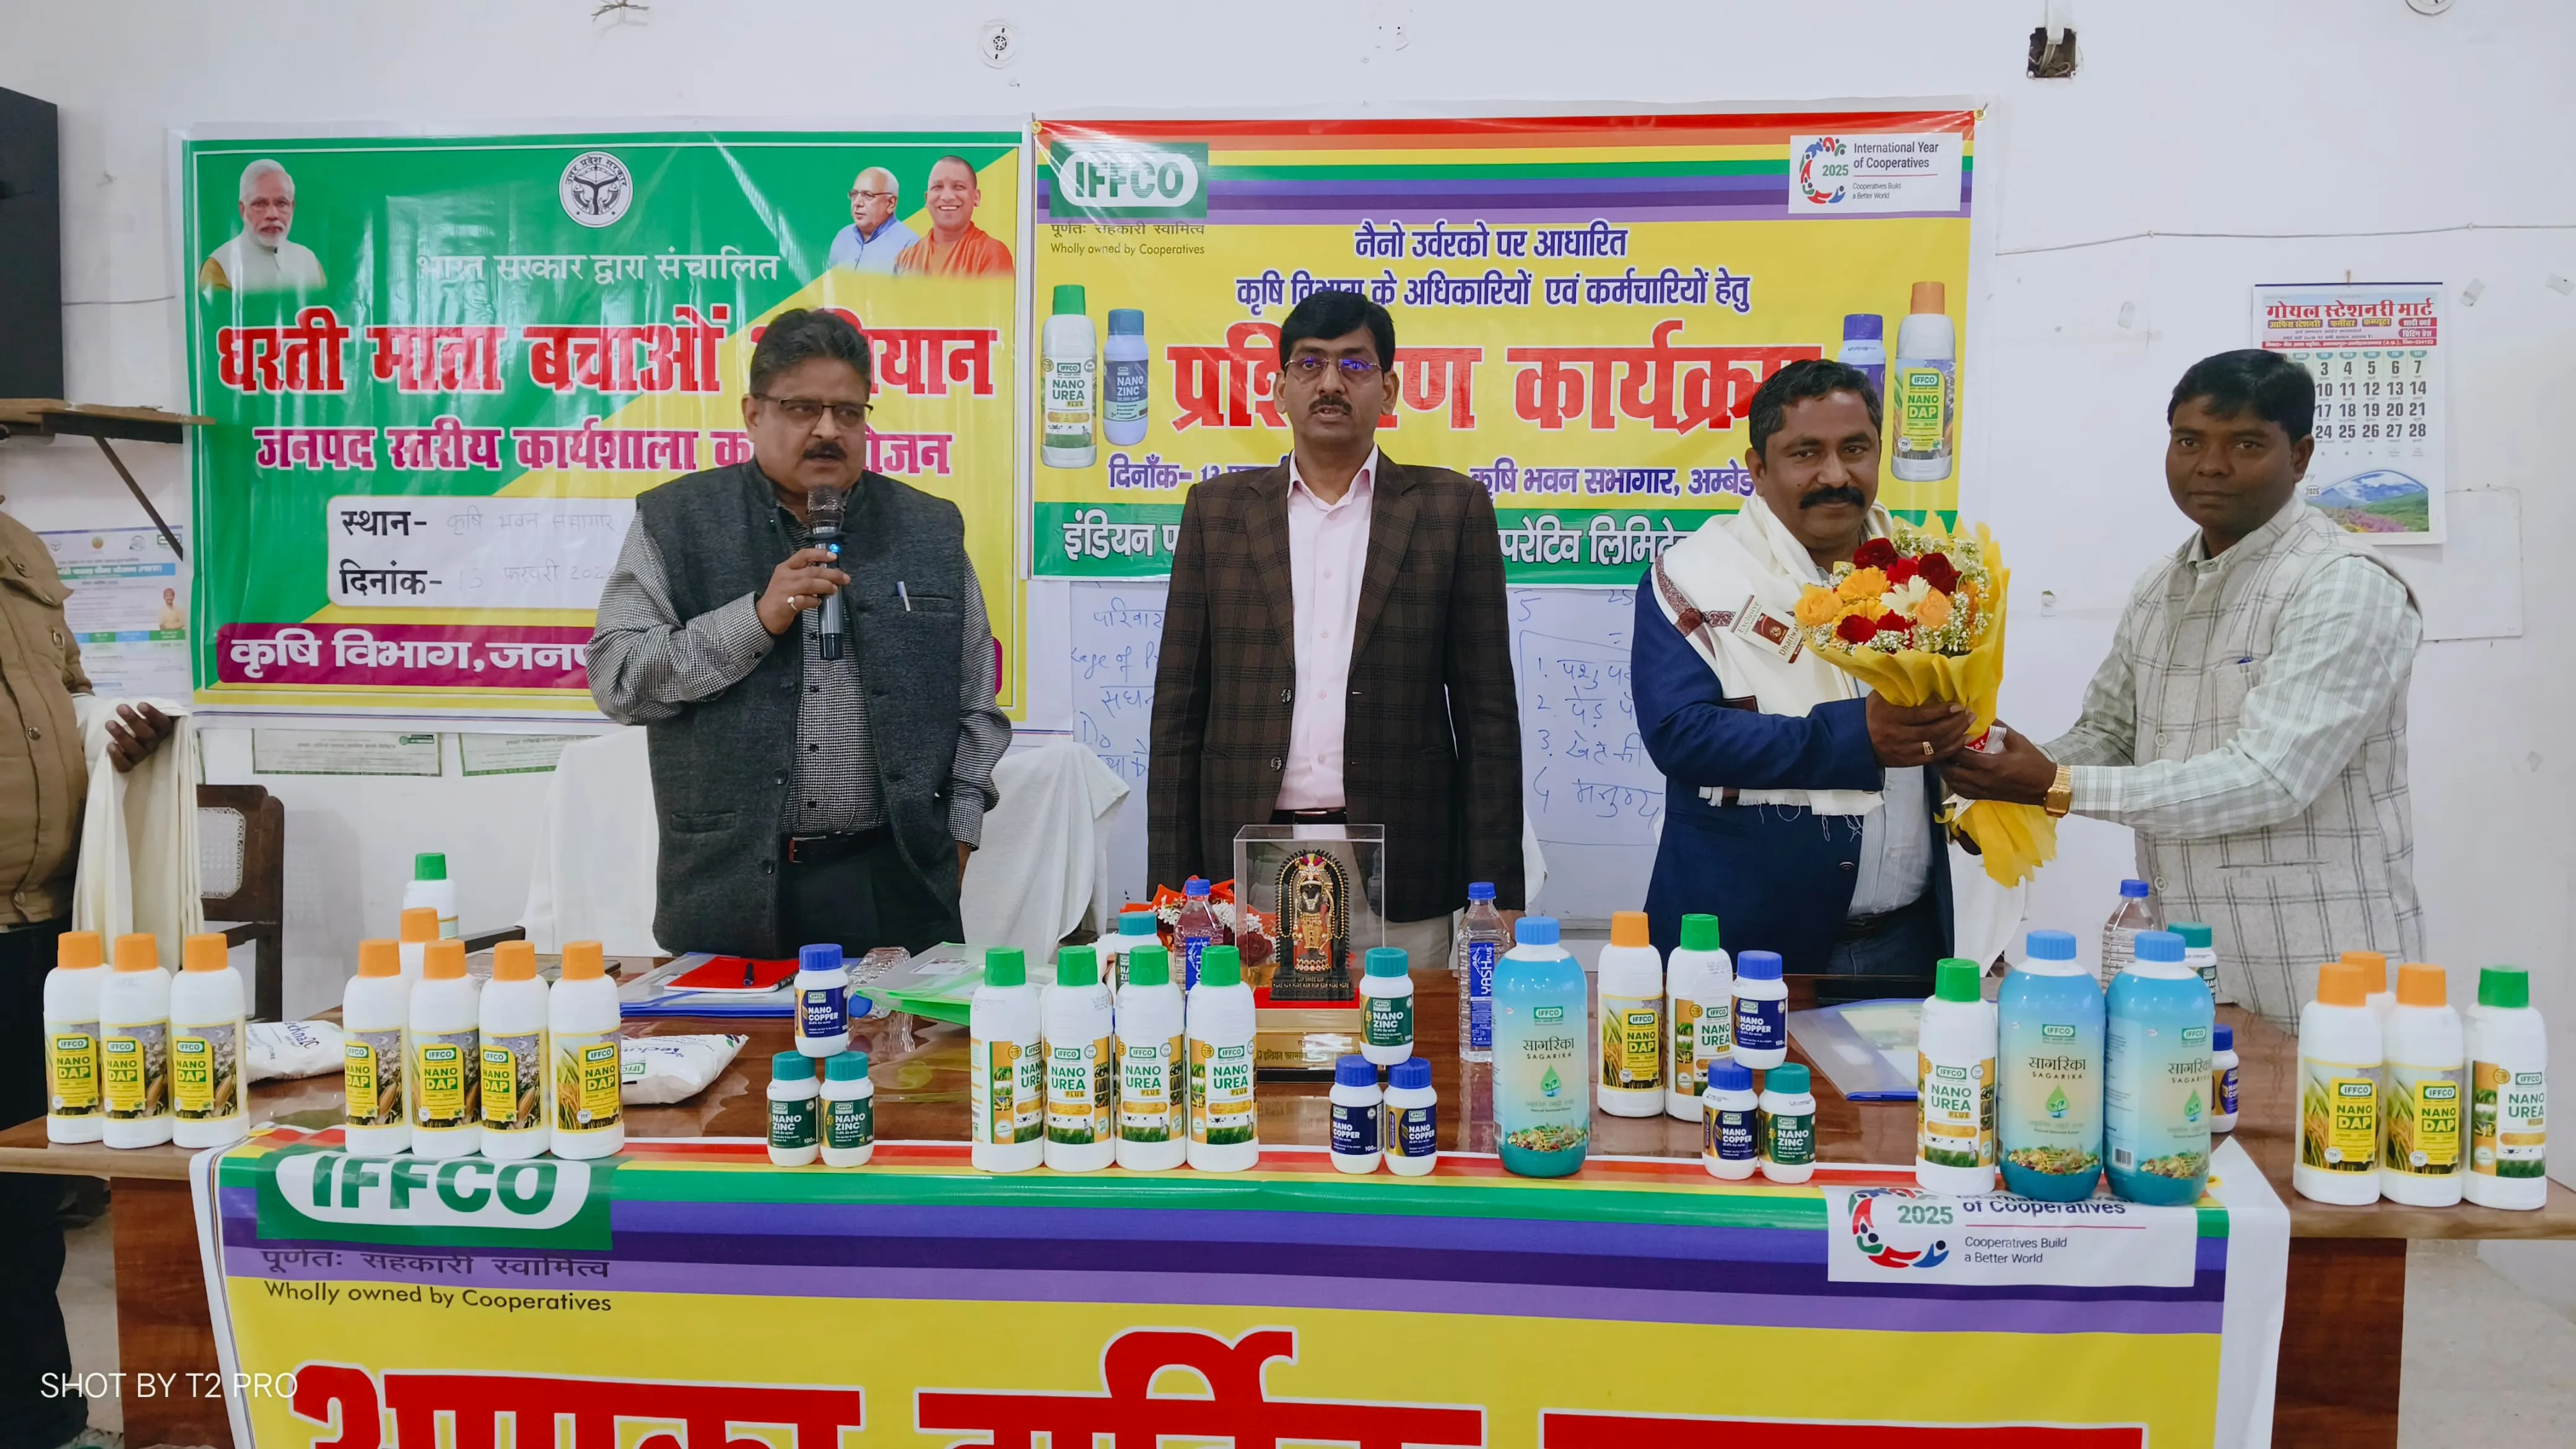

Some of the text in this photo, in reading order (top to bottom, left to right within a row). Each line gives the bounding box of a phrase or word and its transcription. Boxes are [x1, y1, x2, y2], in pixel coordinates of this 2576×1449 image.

[1854, 142, 1939, 154] International Year
[1853, 157, 1930, 170] of Cooperatives
[1822, 165, 1849, 176] 2025
[1076, 161, 1184, 199] IFFCO
[1853, 183, 1886, 191] Cooperatives
[1355, 221, 1629, 258] नैनो उर्वरको पर आधारित
[1051, 243, 1205, 256] Wholly owned by Cooperatives
[416, 245, 781, 284] भारत सरकार द्वारा संचालित
[1236, 268, 1751, 316] कृषि के अधिकारियों एवं कर्मचारियों हेतु
[2266, 298, 2434, 318] गोयल स्टेशनरी मार्ट
[218, 305, 729, 394] धरती माता बचाओं
[2320, 360, 2422, 375] 3 4 5 6 7
[1053, 380, 1085, 389] NANO
[1117, 376, 1144, 386] NANO
[1914, 376, 1934, 384] IFFCO
[1117, 386, 1139, 396] ZINC
[2316, 381, 2426, 396] 10 11 12 13 14
[1053, 390, 1085, 400] UREA
[1907, 395, 1939, 404] NANO
[1908, 406, 1938, 419] DAP
[2316, 402, 2425, 417] 17 18 19 20 21
[2315, 424, 2426, 438] 24 25 26 27 28
[252, 416, 698, 472] जनपद स्तरीय कार्यशाला
[1524, 467, 1579, 494] भवन
[1585, 468, 1681, 497] सभागार,
[341, 510, 427, 537] स्थान-
[1063, 508, 1156, 560] इंडियन
[339, 560, 443, 596] दिनांक-
[1738, 601, 1760, 633] Exclusive
[230, 629, 323, 679] कृषि
[1481, 960, 1492, 994] YASH
[808, 1006, 832, 1014] NANO
[1373, 1011, 1404, 1020] NANO
[808, 1012, 838, 1021] COPPER
[1633, 1015, 1653, 1023] IFFCO
[1373, 1020, 1398, 1029] ZINC
[1627, 1032, 1655, 1040] NANO
[1522, 1036, 1575, 1051] सागरिका
[1629, 1042, 1655, 1053] DAP
[56, 1056, 90, 1066] NANO
[2028, 1055, 2086, 1071] सागरिका
[58, 1067, 89, 1079] DAP
[424, 1067, 458, 1076] NANO
[1052, 1066, 1086, 1077] NANO
[1214, 1064, 1248, 1076] NANO
[1941, 1069, 1962, 1077] IFFCO
[2032, 1071, 2082, 1079] SAGARIKA
[425, 1078, 456, 1090] DAP
[1052, 1078, 1086, 1090] UREA
[1214, 1076, 1248, 1089] UREA
[1931, 1084, 1971, 1097] NANO
[1931, 1096, 1971, 1110] UREA
[2509, 1093, 2544, 1104] NANO
[2337, 1105, 2372, 1114] NANO
[2509, 1105, 2544, 1118] UREA
[2339, 1116, 2371, 1129] DAP
[1778, 1129, 1809, 1138] NANO
[1778, 1138, 1803, 1146] ZINC
[313, 1156, 557, 1215] IFFCO
[1898, 1205, 1953, 1224] 2025
[1965, 1237, 2067, 1249] Cooperatives Build
[1975, 1252, 2008, 1263] Better
[2012, 1253, 2043, 1264] World
[265, 1281, 611, 1312] Wholly owned by Cooperatives
